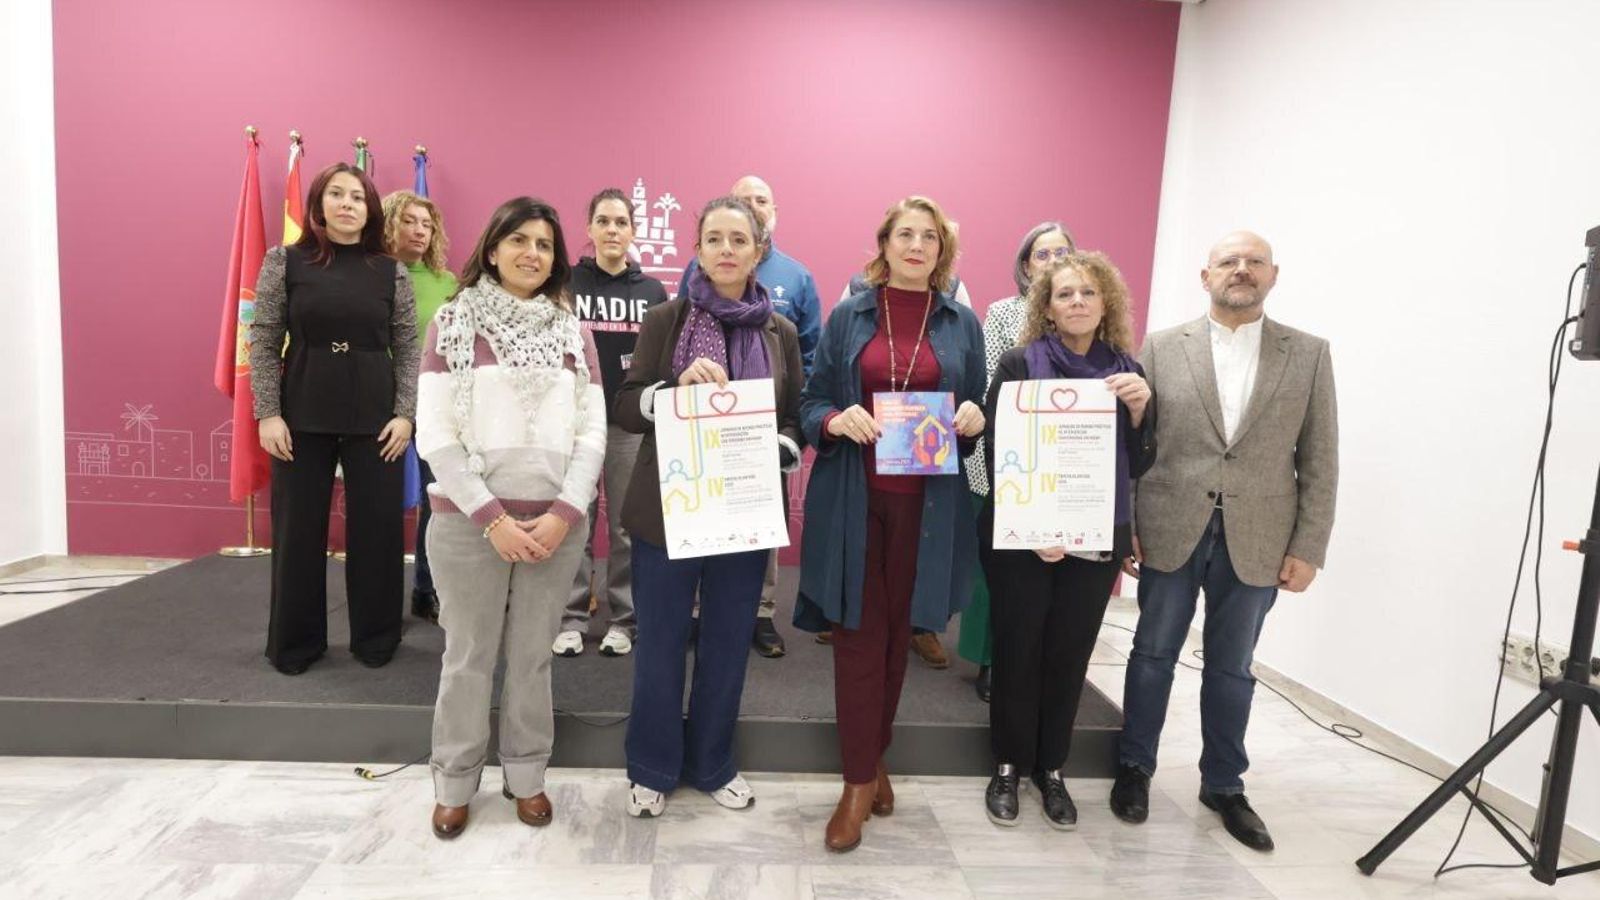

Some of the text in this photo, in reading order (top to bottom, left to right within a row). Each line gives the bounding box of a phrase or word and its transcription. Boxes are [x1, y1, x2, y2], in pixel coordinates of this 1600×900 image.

[704, 429, 720, 448] IX
[1042, 425, 1056, 445] IX
[708, 477, 723, 496] IV
[1041, 473, 1056, 493] IV
